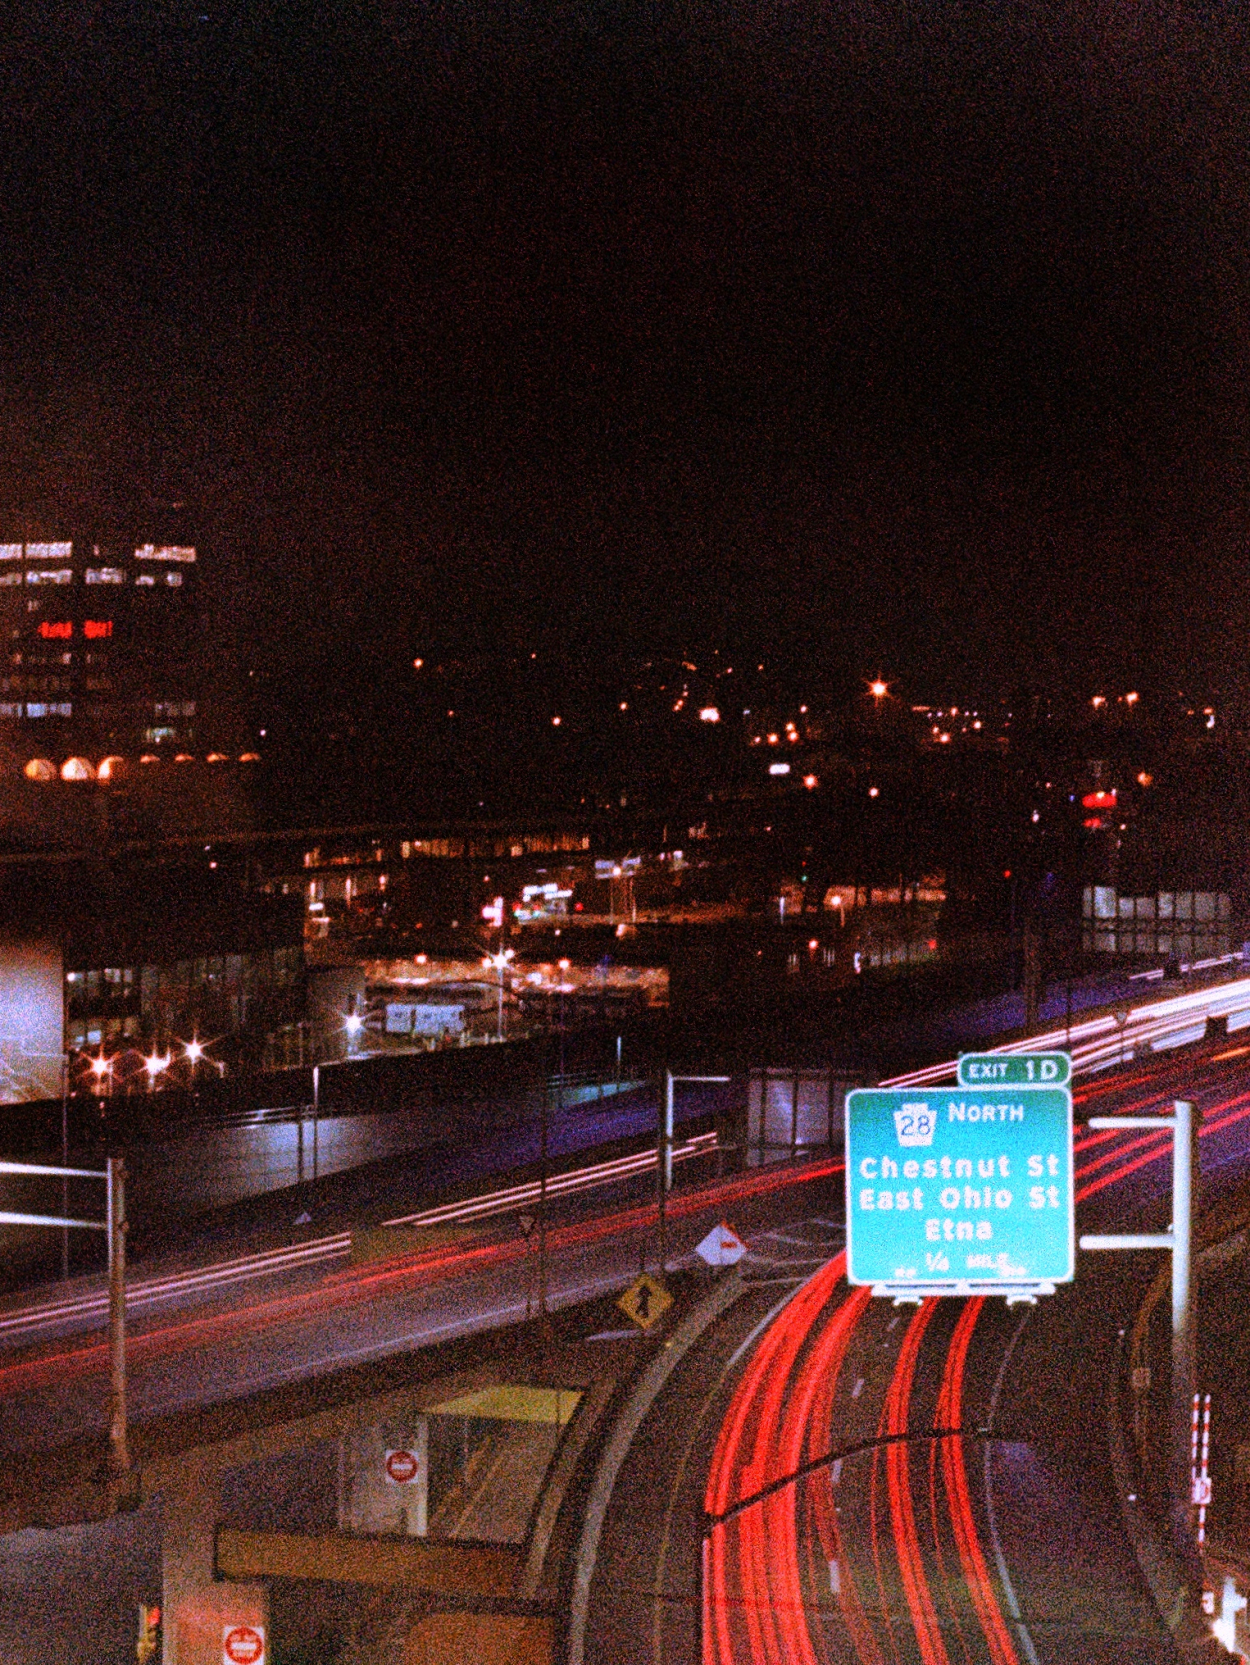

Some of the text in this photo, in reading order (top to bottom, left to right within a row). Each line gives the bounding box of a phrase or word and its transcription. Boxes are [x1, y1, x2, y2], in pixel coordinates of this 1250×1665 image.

[968, 1060, 1058, 1080] EXIT 1D
[900, 1102, 1024, 1136] 28 NORTH
[859, 1154, 1060, 1179] Chestnut St
[859, 1185, 1060, 1210] East Ohio St
[925, 1219, 992, 1240] Etna
